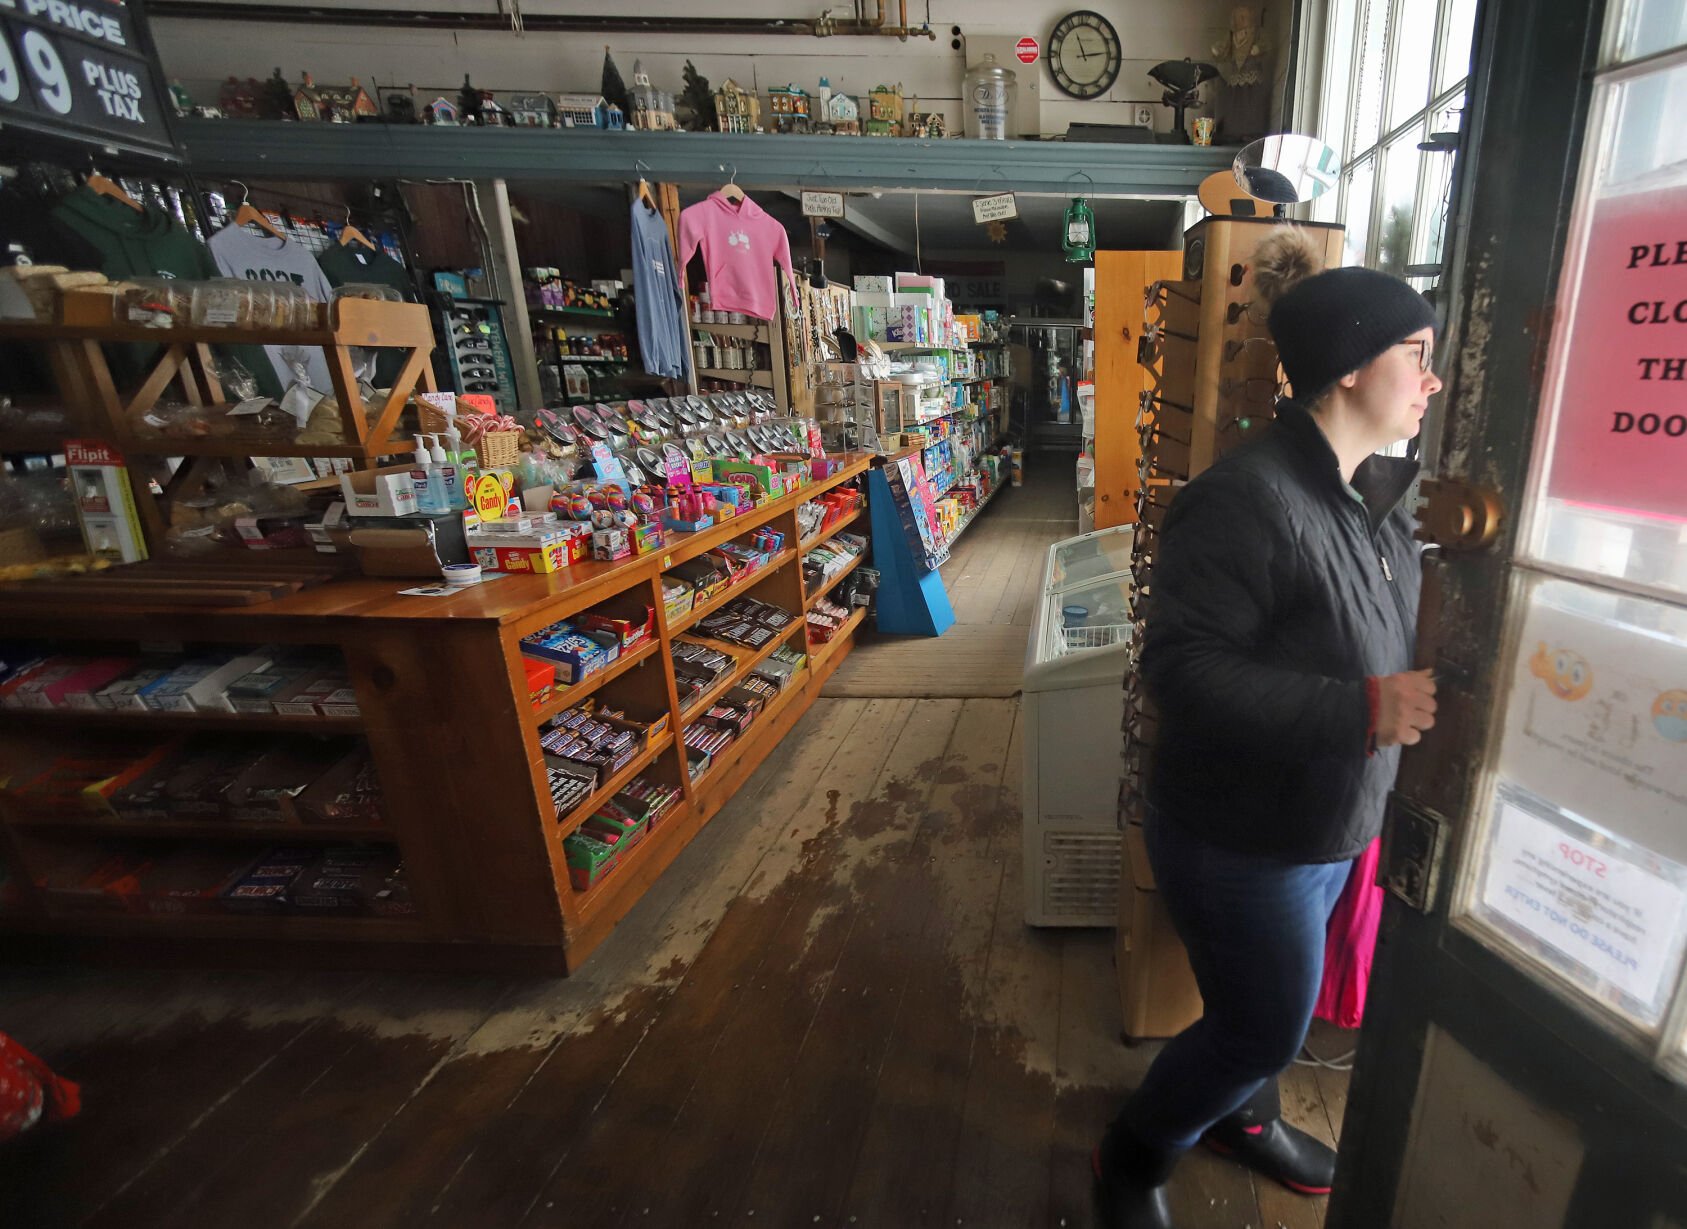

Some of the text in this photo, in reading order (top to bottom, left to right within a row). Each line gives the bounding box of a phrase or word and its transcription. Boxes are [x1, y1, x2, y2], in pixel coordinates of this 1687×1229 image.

[24, 0, 126, 46] PRICE
[82, 60, 142, 99] PLUS
[97, 89, 145, 123] TAX
[967, 281, 1001, 298] SALE
[1638, 358, 1687, 381] TH
[1610, 411, 1687, 436] DOO
[68, 448, 110, 463] Flipit
[480, 493, 502, 511] Candy
[505, 558, 529, 571] Candy
